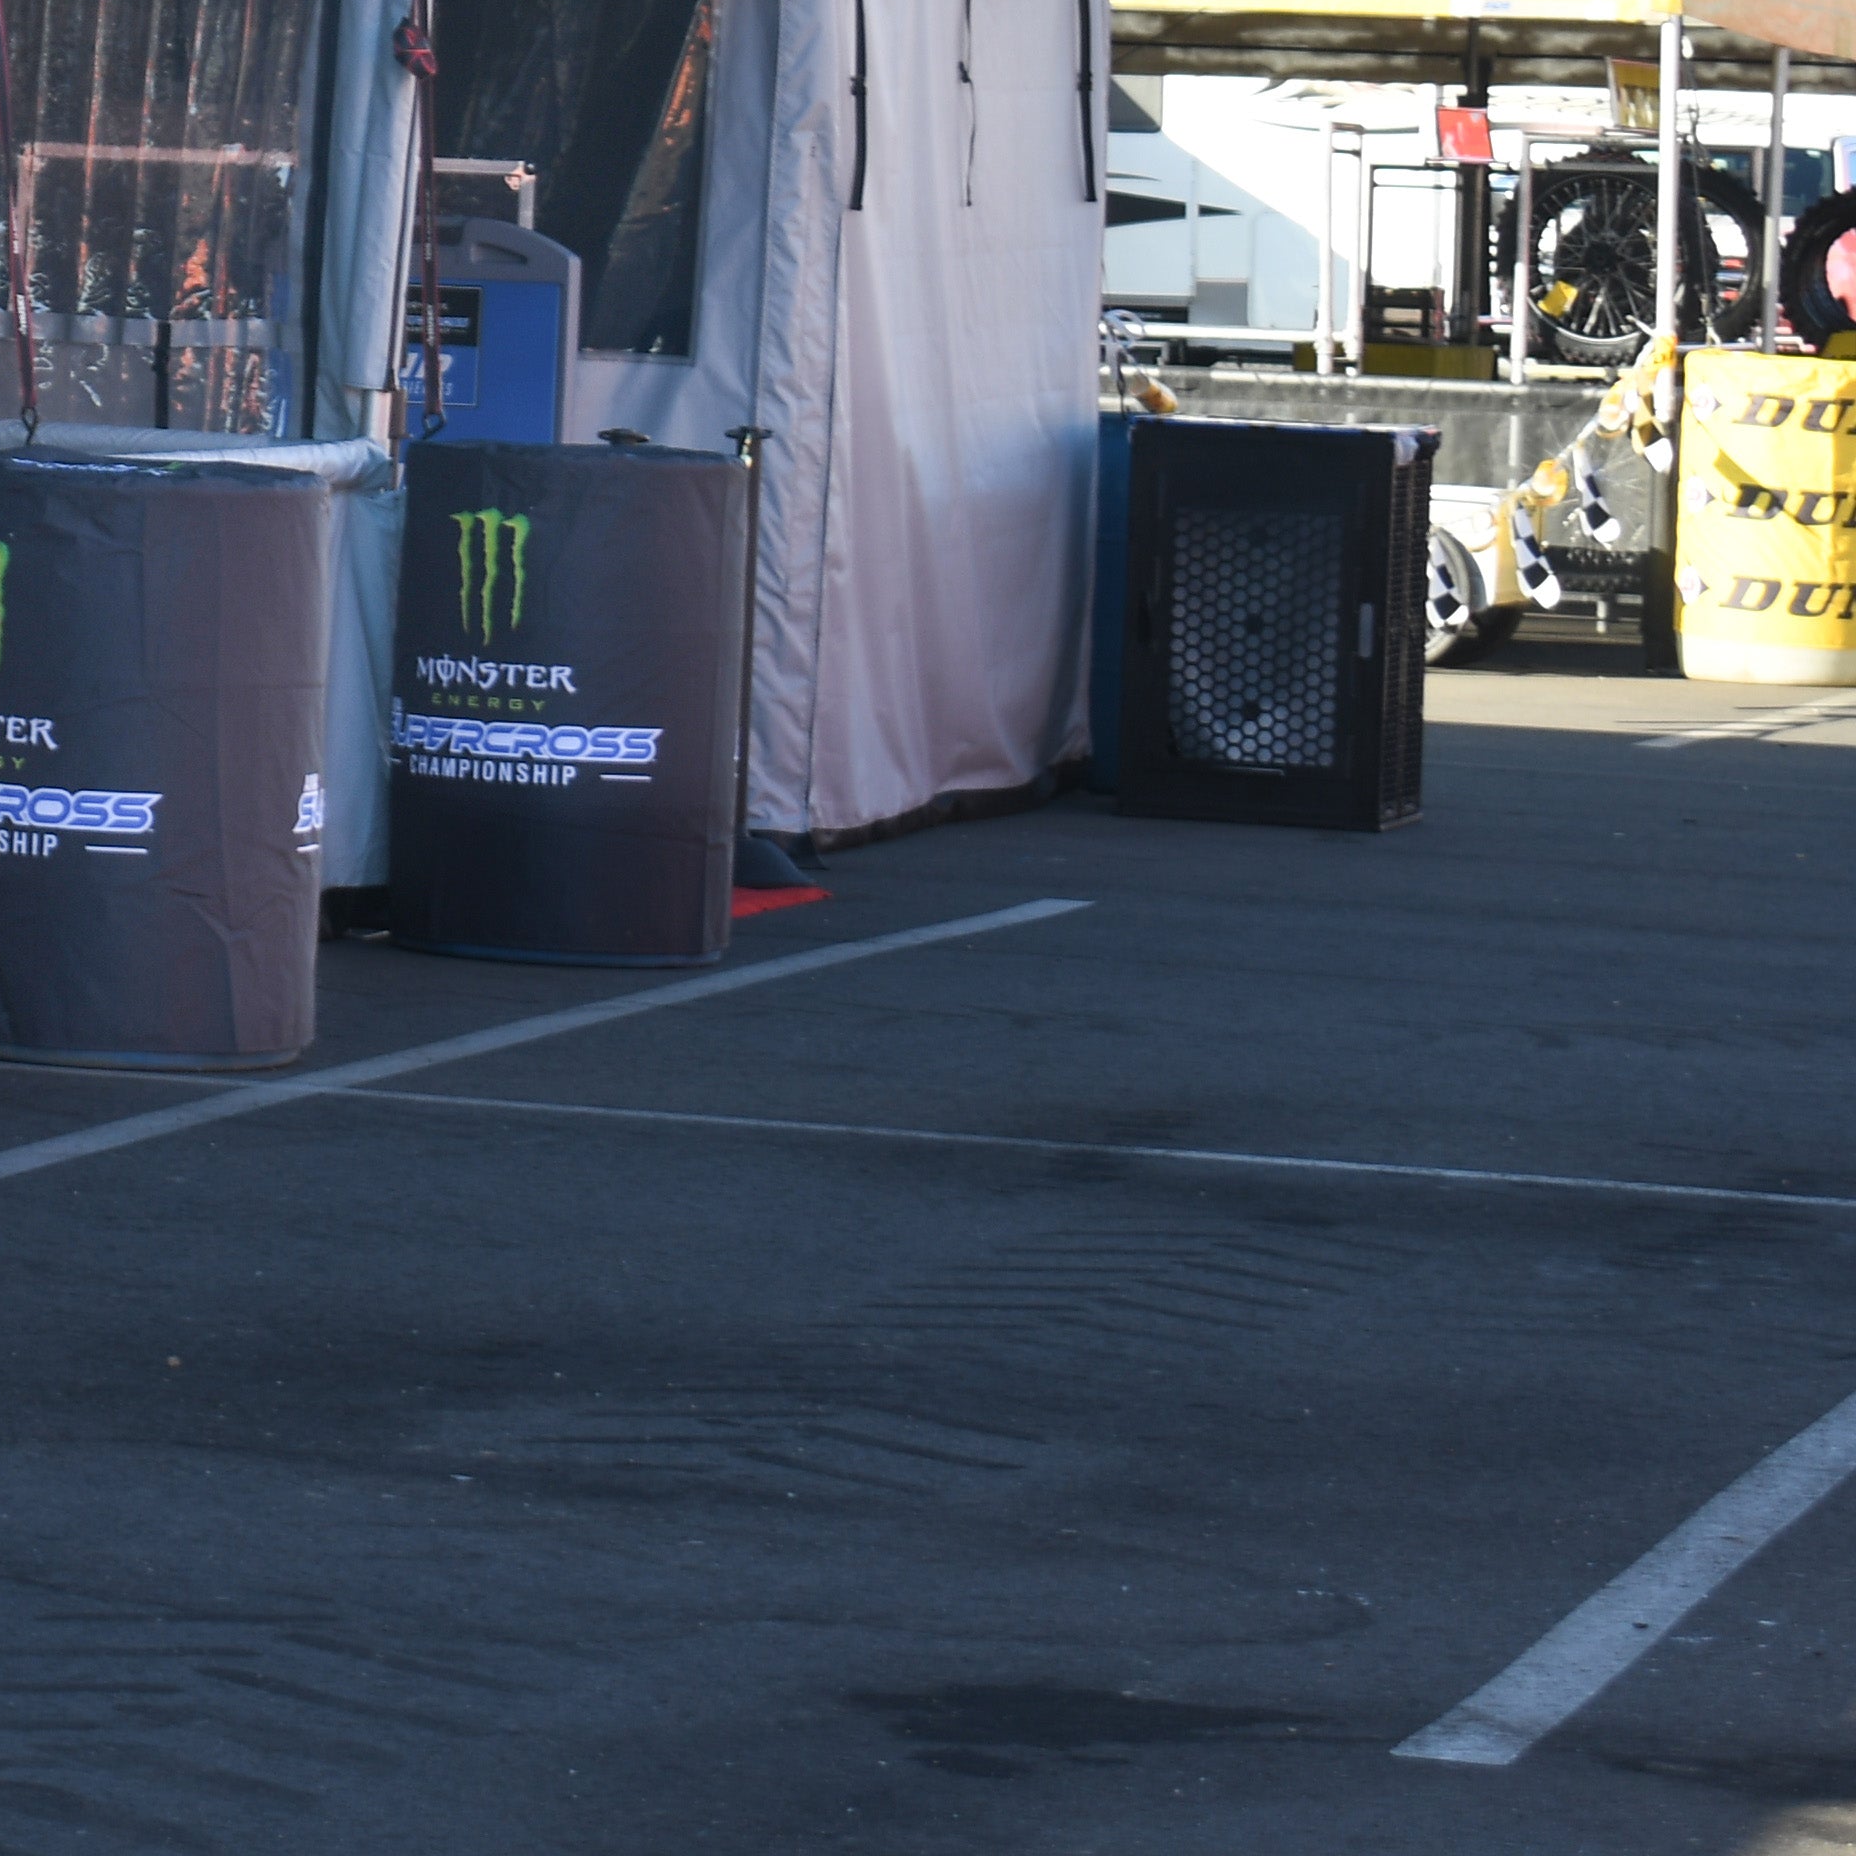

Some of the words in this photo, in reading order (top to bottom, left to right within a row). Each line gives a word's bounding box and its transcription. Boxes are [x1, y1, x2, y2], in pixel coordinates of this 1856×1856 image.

[415, 653, 578, 694] MONSTER
[430, 692, 546, 711] ENERGY
[408, 753, 578, 786] CHAMPIONSHIP
